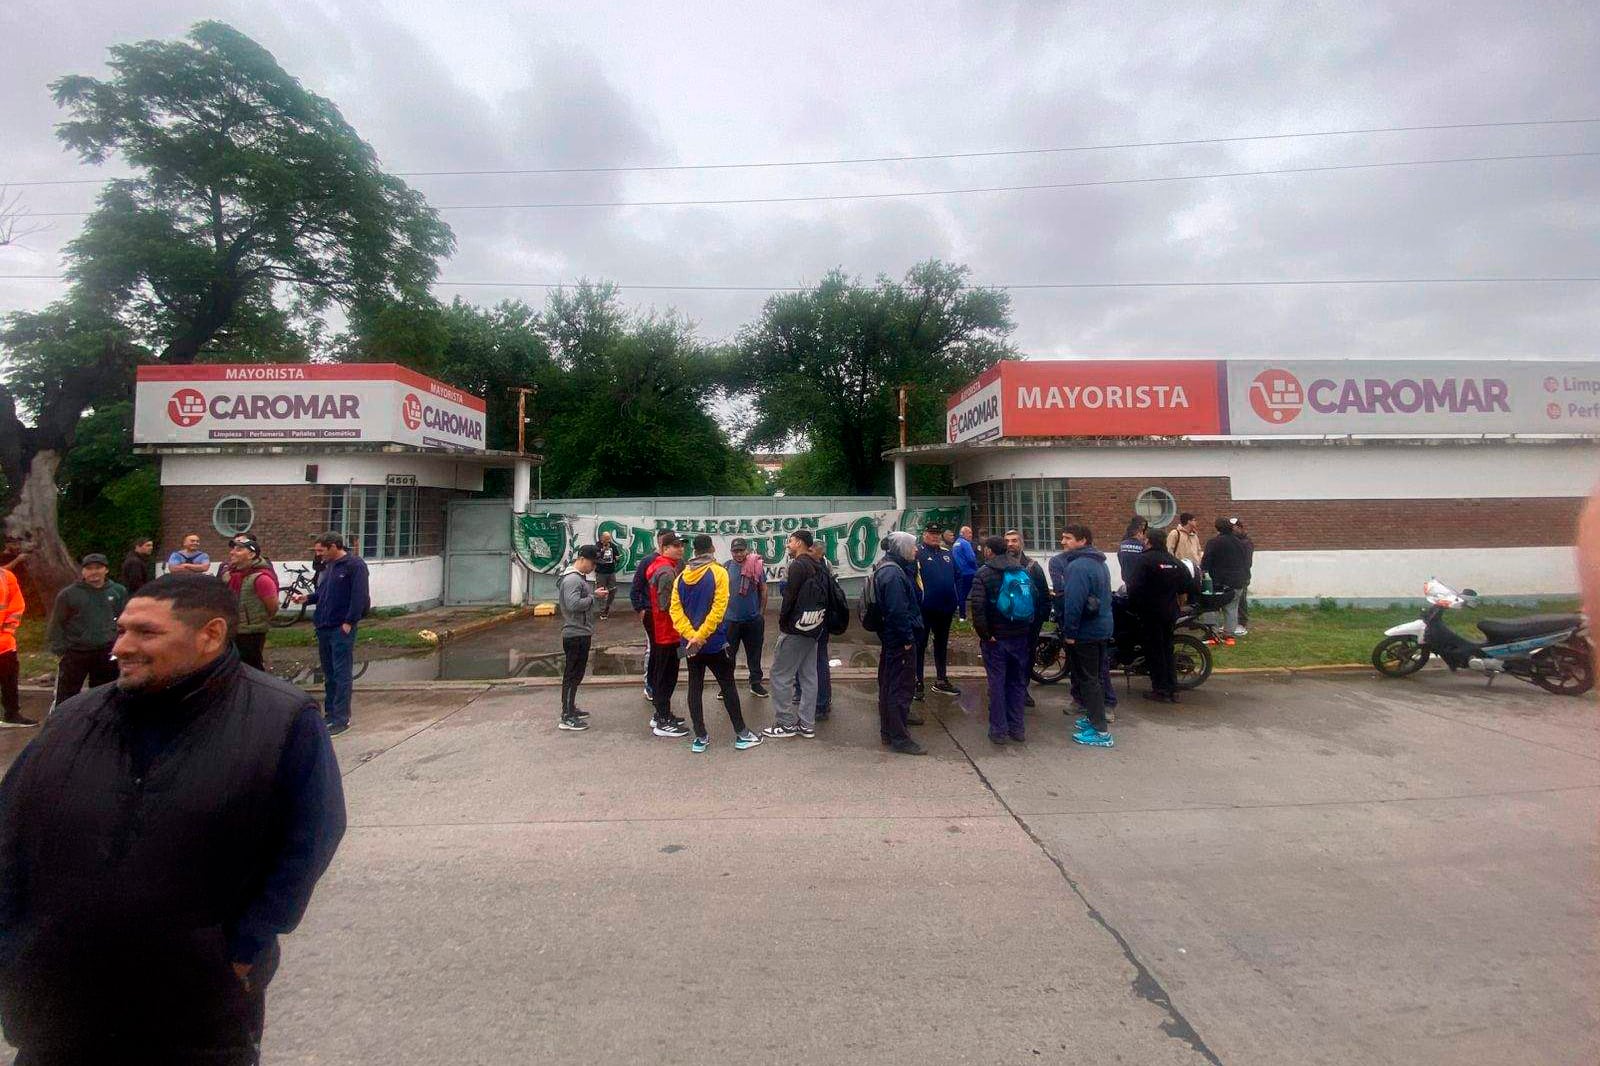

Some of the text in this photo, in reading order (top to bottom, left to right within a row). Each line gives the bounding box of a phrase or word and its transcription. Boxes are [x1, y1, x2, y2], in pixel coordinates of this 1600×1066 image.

[225, 368, 305, 379] MAYORISTA
[430, 383, 464, 404] MAYORISTA
[1307, 378, 1511, 413] CAROMAR
[1563, 376, 1600, 396] Limp
[209, 395, 360, 419] CAROMAR
[1017, 386, 1189, 408] MAYORISTA
[957, 395, 999, 433] CAROMAR
[1568, 402, 1600, 418] Perf
[423, 405, 482, 440] CAROMAR
[655, 517, 820, 534] DELEGACION
[597, 516, 879, 575] SA UTO
[801, 609, 826, 625] NIKE
